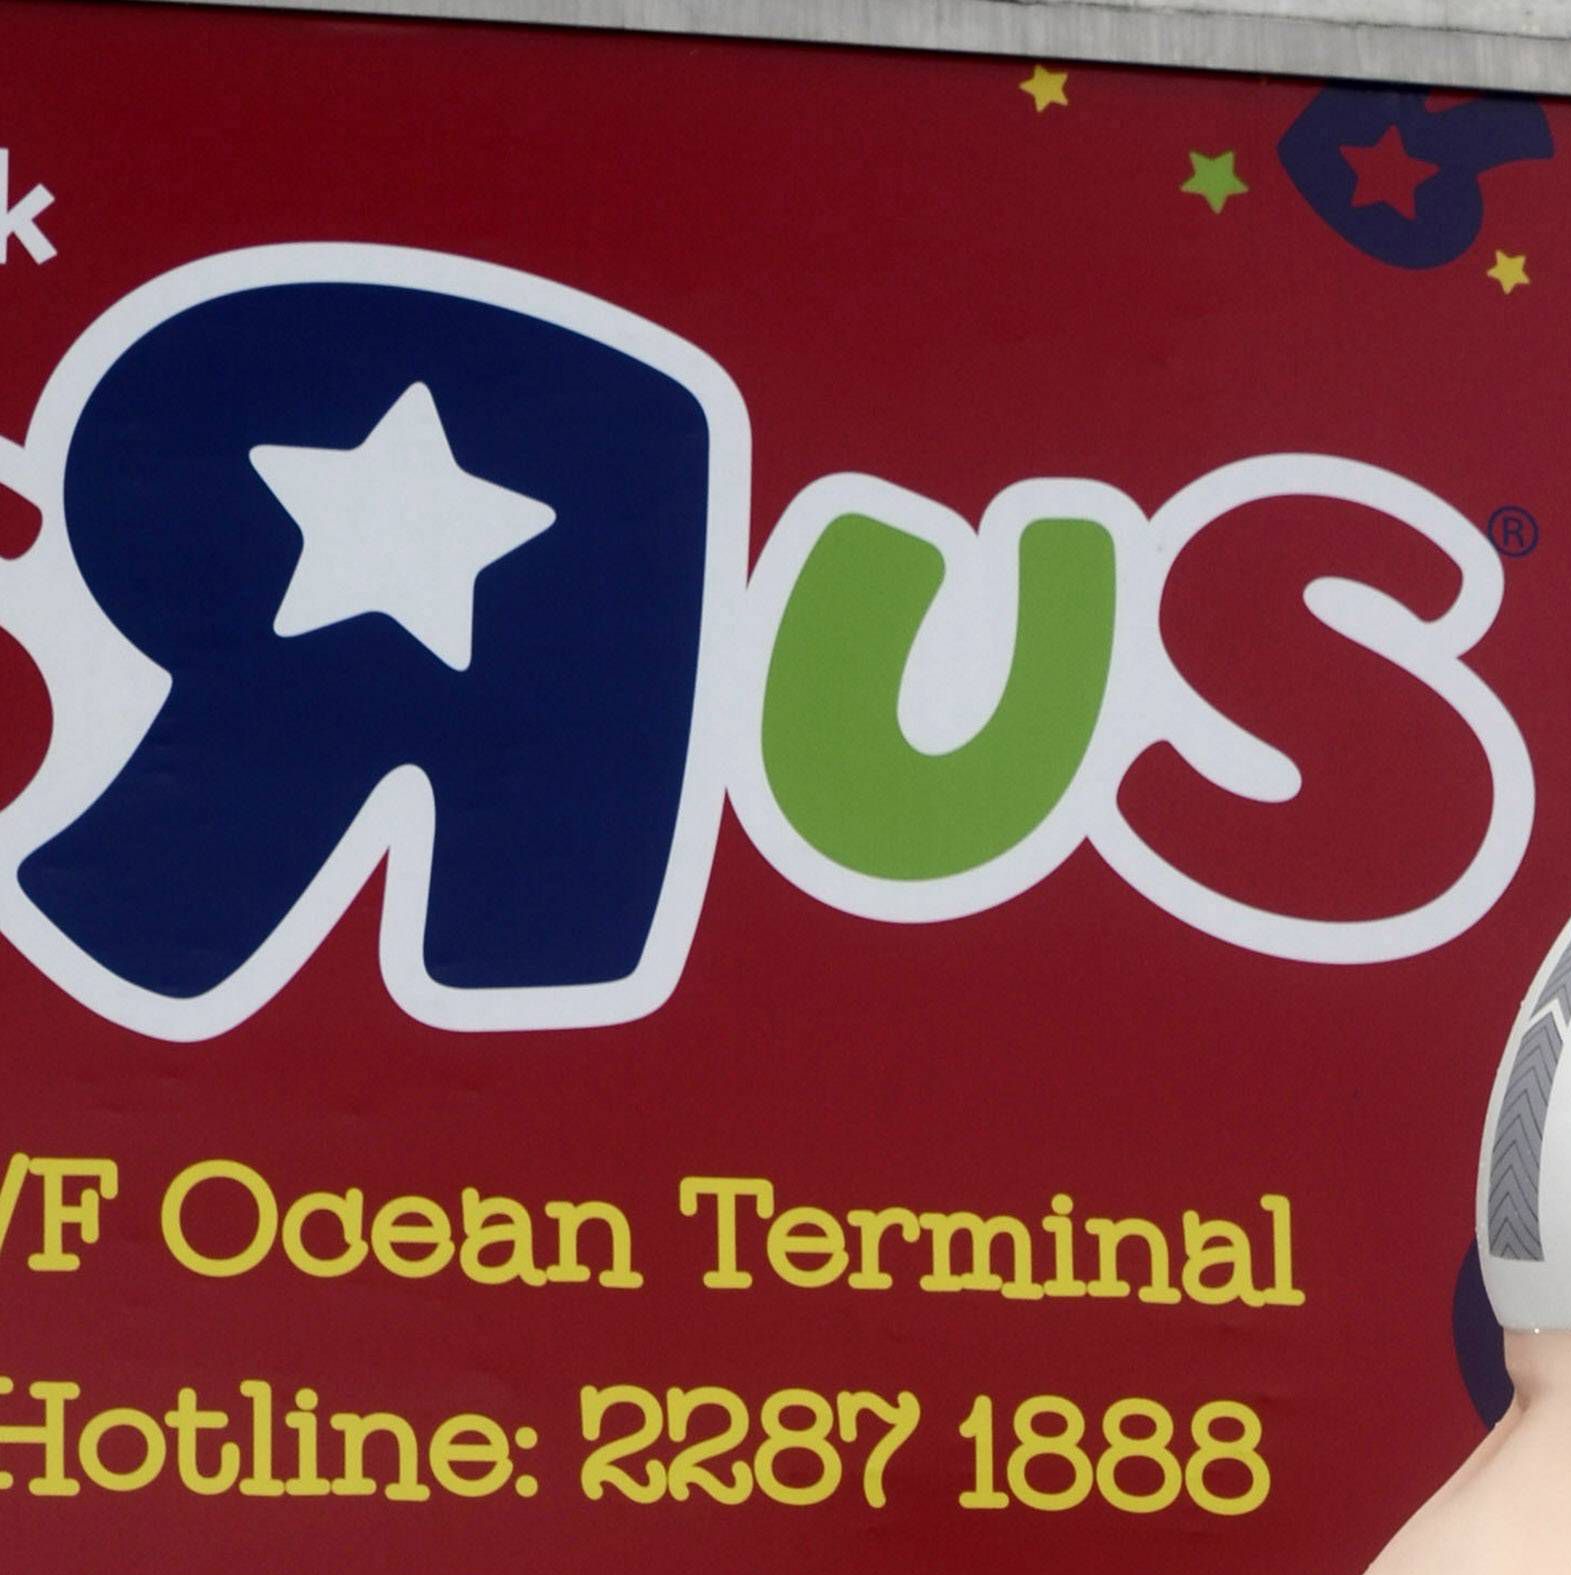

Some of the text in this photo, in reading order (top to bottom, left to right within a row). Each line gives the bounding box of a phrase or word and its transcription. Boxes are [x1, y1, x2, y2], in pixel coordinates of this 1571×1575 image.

[160, 1158, 645, 1290] Ocean
[679, 1176, 1306, 1308] Terminal
[0, 1375, 1272, 1517] Hotline: 2287 1888
